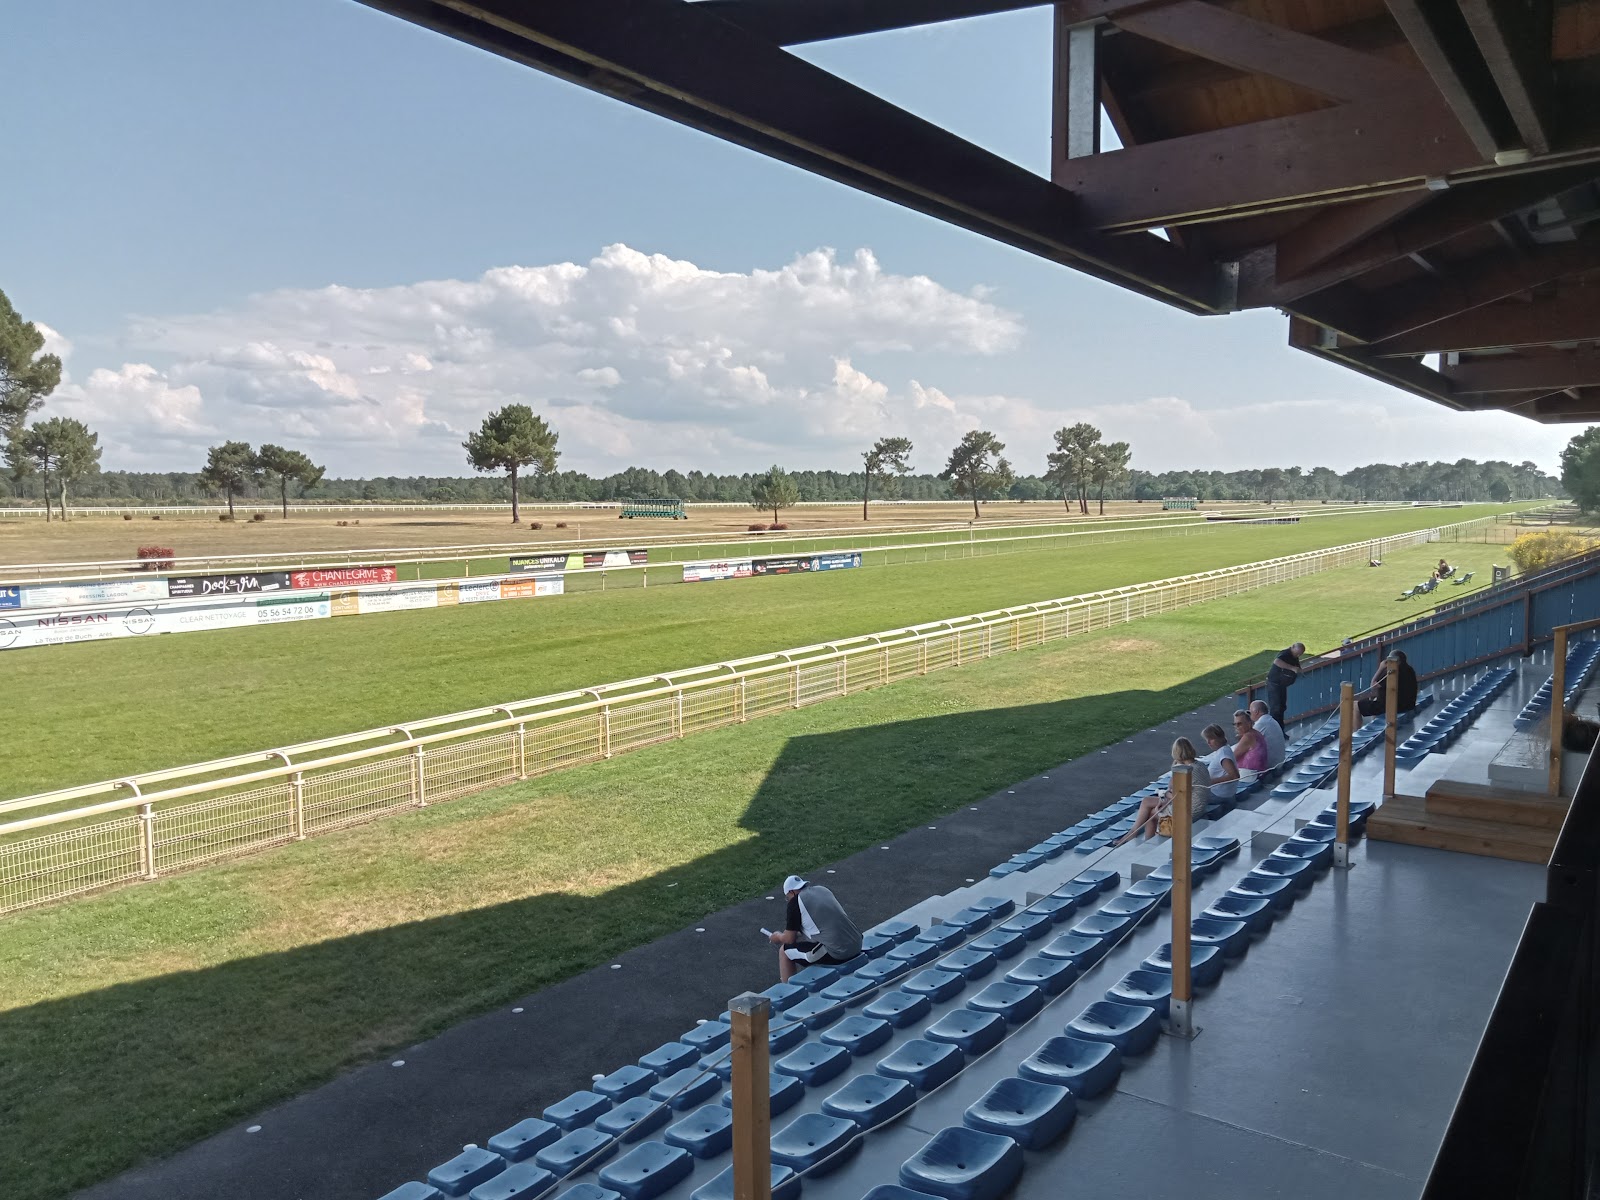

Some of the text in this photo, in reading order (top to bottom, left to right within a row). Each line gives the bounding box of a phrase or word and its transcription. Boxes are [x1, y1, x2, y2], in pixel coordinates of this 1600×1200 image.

[312, 568, 378, 582] CHANTEGRIVE
[201, 575, 230, 595] Dock
[179, 611, 247, 624] CLEAR NETTOYAGE
[257, 606, 314, 618] 05 56 54 72 06
[38, 614, 108, 627] NISSAN
[122, 617, 156, 625] NISSAN
